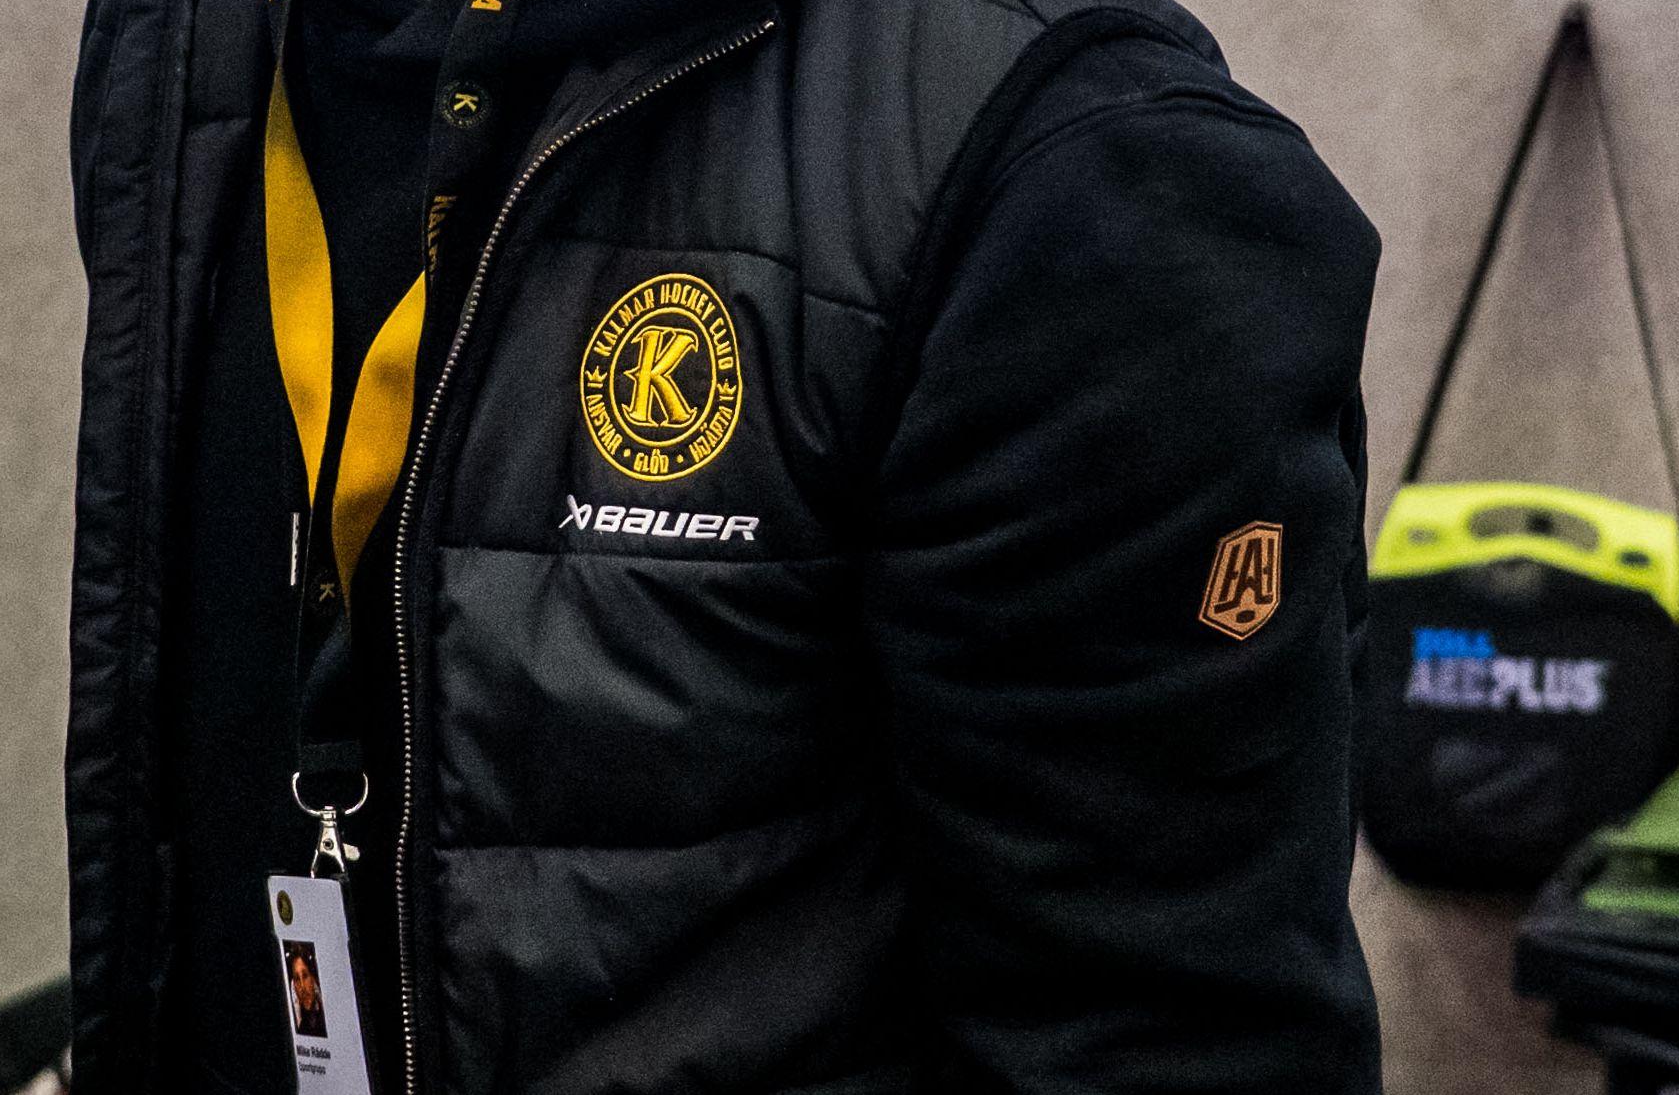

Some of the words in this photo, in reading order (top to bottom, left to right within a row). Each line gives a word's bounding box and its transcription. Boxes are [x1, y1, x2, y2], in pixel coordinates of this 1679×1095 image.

[593, 288, 655, 358] KALMAR
[660, 282, 717, 321] HOCKEY
[623, 325, 699, 428] K
[585, 393, 624, 456] ANSVAR
[633, 448, 670, 475] GLÖD
[688, 405, 734, 464] HJÄRTA
